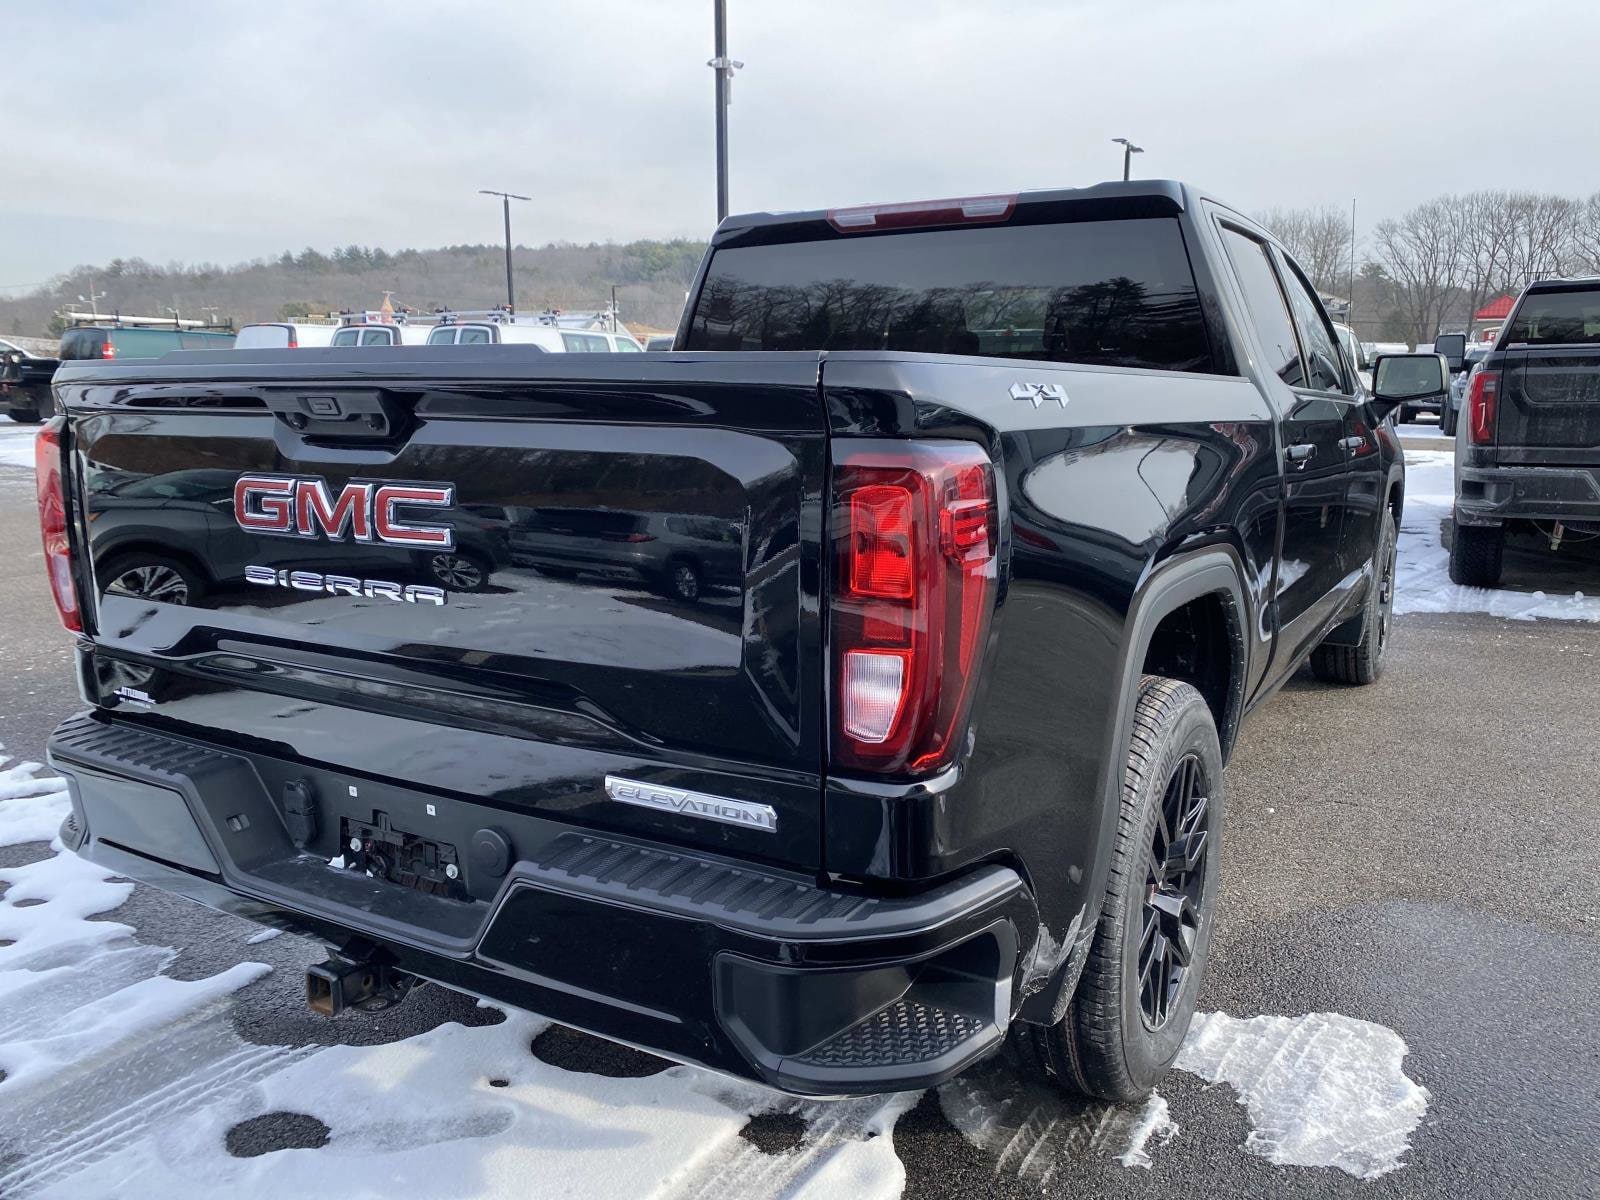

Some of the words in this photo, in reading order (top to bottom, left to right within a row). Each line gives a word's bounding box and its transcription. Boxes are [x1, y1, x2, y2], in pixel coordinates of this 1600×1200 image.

[233, 474, 455, 551] GMC
[244, 564, 449, 606] SIERRA
[618, 785, 763, 824] ELEVATION
